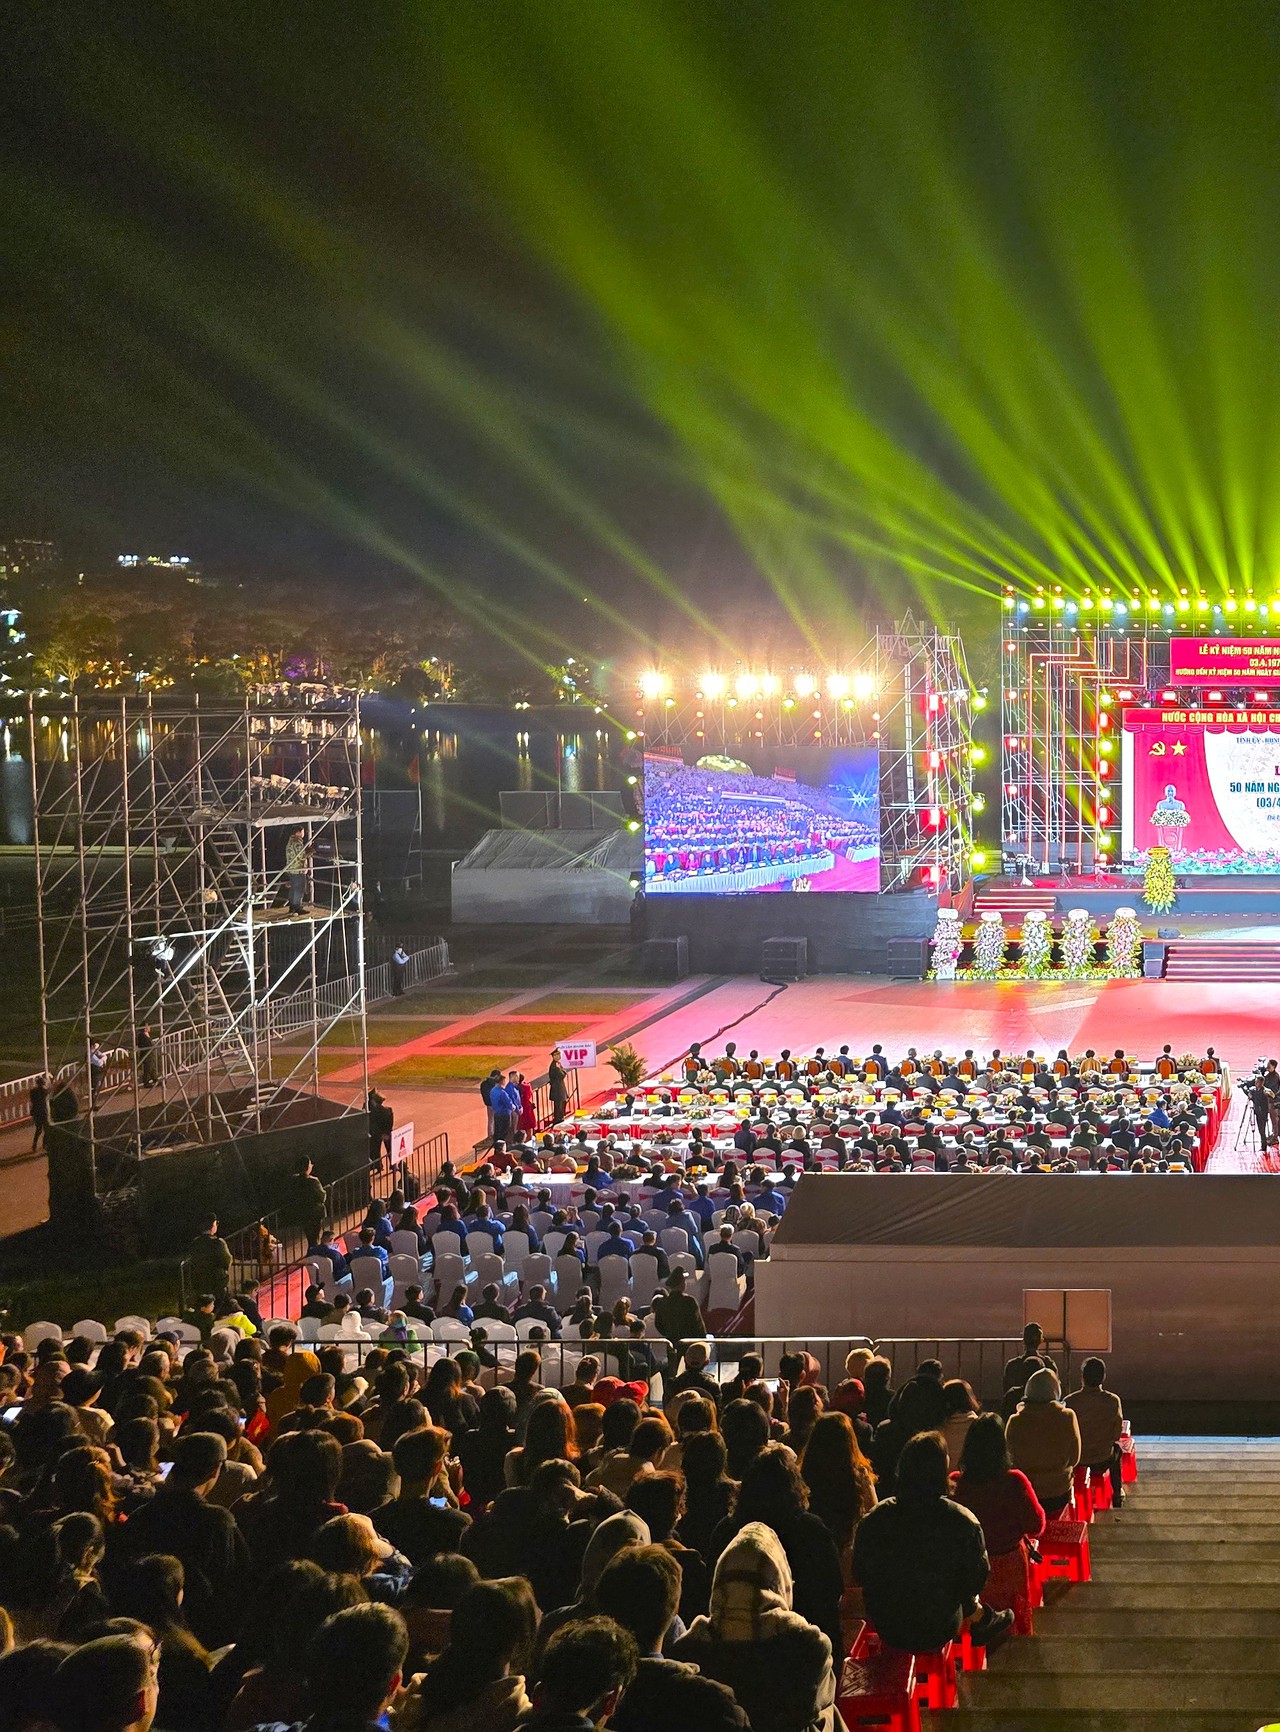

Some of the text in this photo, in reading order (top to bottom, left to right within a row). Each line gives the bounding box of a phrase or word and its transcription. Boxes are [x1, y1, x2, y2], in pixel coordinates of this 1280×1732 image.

[1199, 644, 1208, 655] LỄ
[1210, 644, 1220, 655] KỶ
[1222, 645, 1241, 656] NIỆM
[1243, 646, 1252, 655] 50
[1254, 645, 1272, 655] NĂM
[1161, 711, 1187, 722] NƯỚC
[1188, 711, 1213, 724] CỘNG
[1236, 711, 1248, 723] XÃ
[1250, 711, 1267, 724] HỘI
[1230, 782, 1241, 792] 50
[1245, 780, 1265, 792] NĂM
[563, 1049, 588, 1060] VIP
[400, 1136, 406, 1150] A
